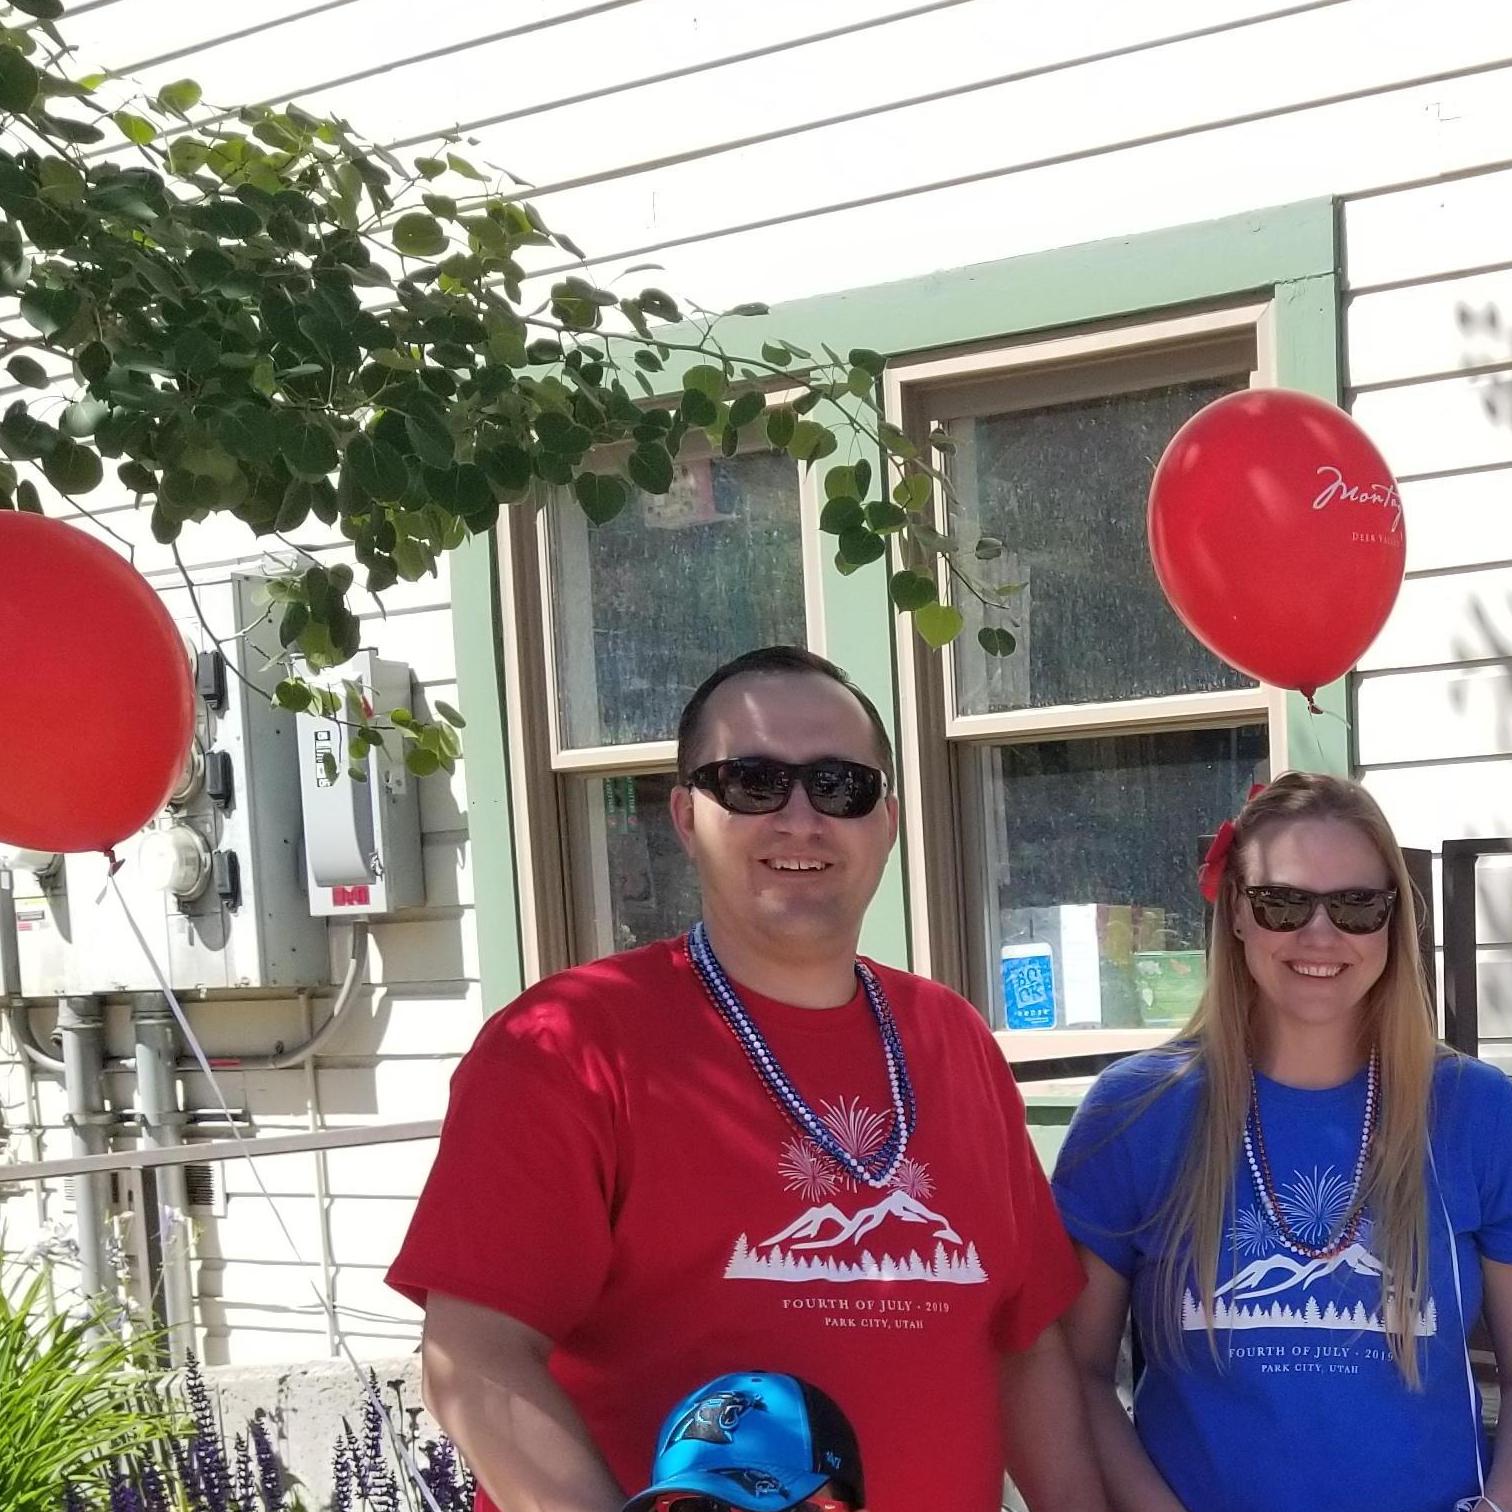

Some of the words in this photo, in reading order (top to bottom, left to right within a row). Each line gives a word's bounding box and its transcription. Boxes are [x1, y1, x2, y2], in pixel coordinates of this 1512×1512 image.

[783, 1298, 849, 1311] FOURTH
[855, 1299, 875, 1311] OF
[879, 1300, 912, 1313] JULY
[925, 1301, 950, 1314] 2019
[824, 1316, 857, 1328] PARK
[861, 1318, 892, 1330] CITY,
[895, 1319, 924, 1330] UTAH
[1229, 1346, 1286, 1359] FOURTH
[1291, 1346, 1311, 1357] OF
[1314, 1346, 1350, 1360] JULY
[1261, 1364, 1290, 1374] PARK
[1329, 1364, 1359, 1375] UTAH
